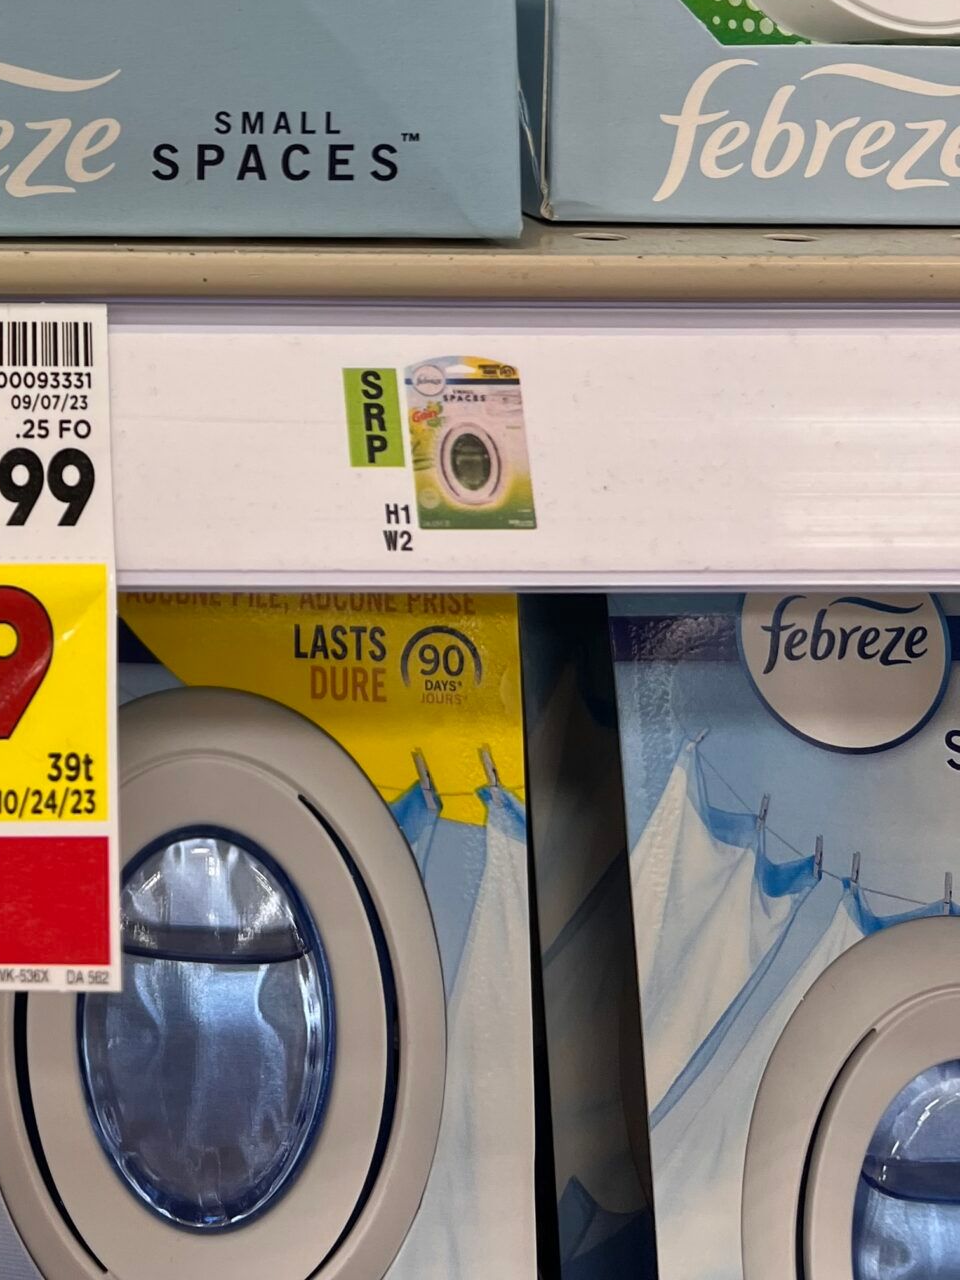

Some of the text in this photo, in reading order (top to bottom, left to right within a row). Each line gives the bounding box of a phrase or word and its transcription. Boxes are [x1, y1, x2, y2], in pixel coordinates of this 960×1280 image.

[214, 110, 342, 135] SMALL
[151, 142, 399, 182] SPACES
[11, 393, 88, 412] 09/07/23
[15, 420, 50, 439] .25
[59, 420, 91, 439] FO
[385, 503, 411, 525] H1
[383, 531, 414, 552] W2
[294, 624, 387, 662] LASTS
[761, 594, 928, 675] febreze
[418, 643, 464, 677] 90
[310, 666, 387, 702] DURE
[47, 753, 93, 782] 39t
[66, 970, 83, 984] DA
